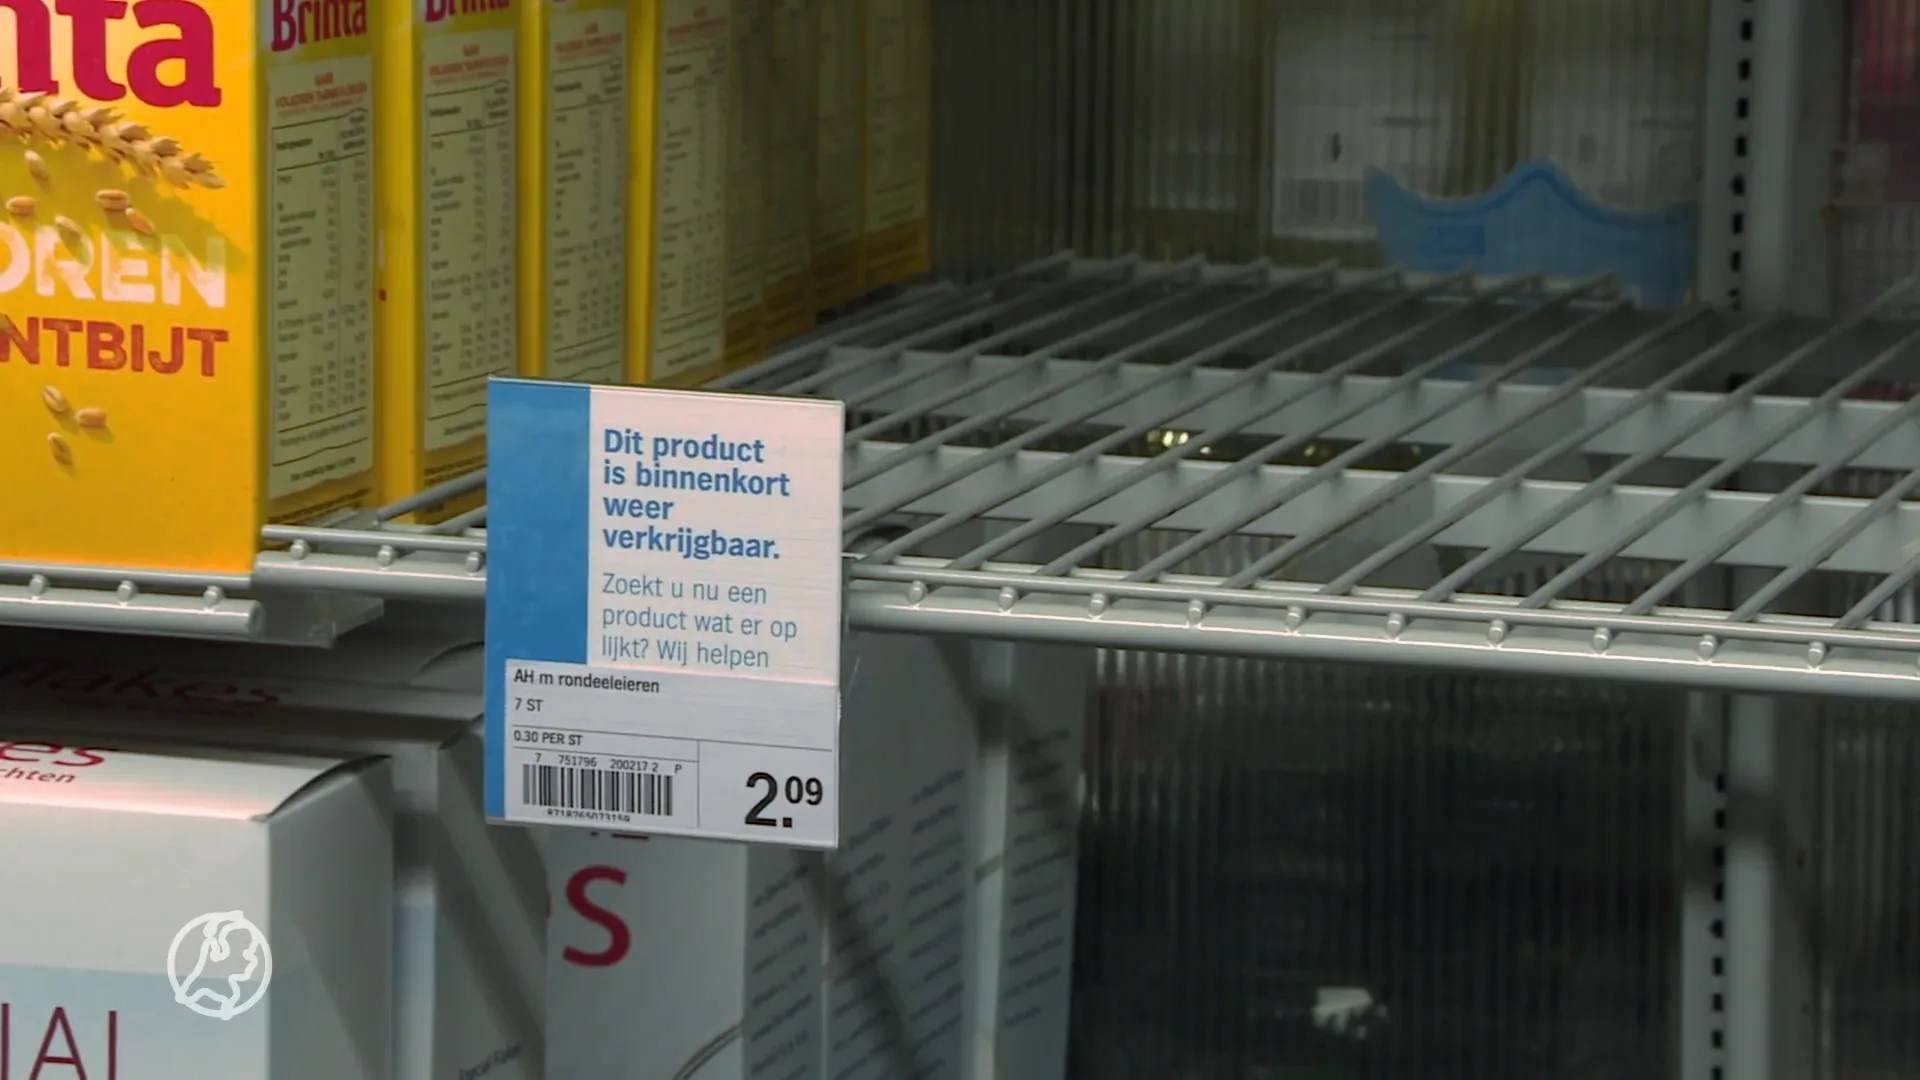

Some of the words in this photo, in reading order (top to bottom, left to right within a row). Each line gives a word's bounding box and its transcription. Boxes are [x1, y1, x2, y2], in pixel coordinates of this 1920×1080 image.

[271, 0, 367, 52] Brinta
[0, 315, 229, 377] NTBIJT
[604, 428, 644, 455] Dit
[652, 433, 765, 463] product
[603, 459, 626, 485] is
[635, 461, 790, 497] binnenkort
[602, 497, 674, 520] weer
[602, 525, 780, 560] verkrijgbaar.
[602, 572, 663, 598] Zoekt
[671, 582, 684, 598] u
[694, 583, 719, 601] nu
[728, 586, 767, 604] een
[602, 607, 687, 631] product
[694, 613, 733, 634] wat
[741, 617, 763, 636] er
[770, 619, 797, 642] op
[602, 634, 649, 662] lijkt?
[657, 639, 687, 667] Wij
[697, 642, 769, 670] helpen
[513, 668, 534, 684] AH
[539, 673, 553, 686] m
[558, 673, 660, 693] rondeeleieren
[514, 697, 523, 711] 7
[526, 698, 543, 713] ST
[513, 730, 538, 743] 0.30
[541, 732, 564, 745] PER
[568, 735, 583, 747] ST
[0, 767, 75, 783] hten
[535, 752, 542, 763] 7
[558, 754, 597, 767] 751796
[609, 758, 648, 772] 200217
[674, 764, 683, 775] P
[744, 771, 824, 828] 2.09
